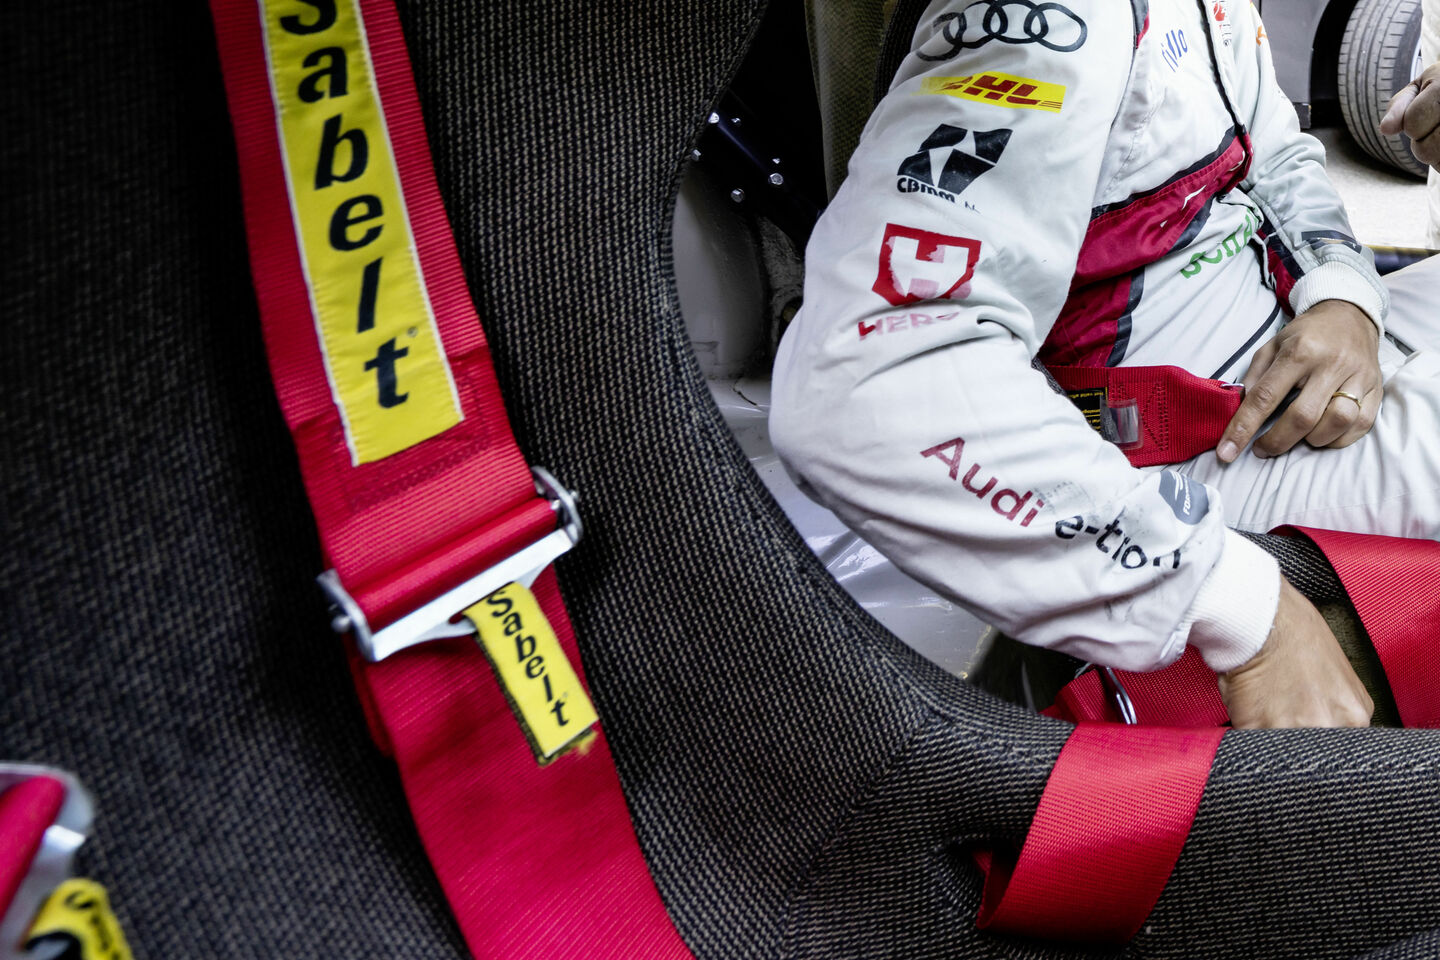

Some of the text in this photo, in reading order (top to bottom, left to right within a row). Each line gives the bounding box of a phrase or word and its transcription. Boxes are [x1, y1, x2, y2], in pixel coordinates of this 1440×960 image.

[940, 74, 1040, 106] DHL
[921, 438, 1044, 527] Audi
[485, 592, 570, 727] Sabelt
